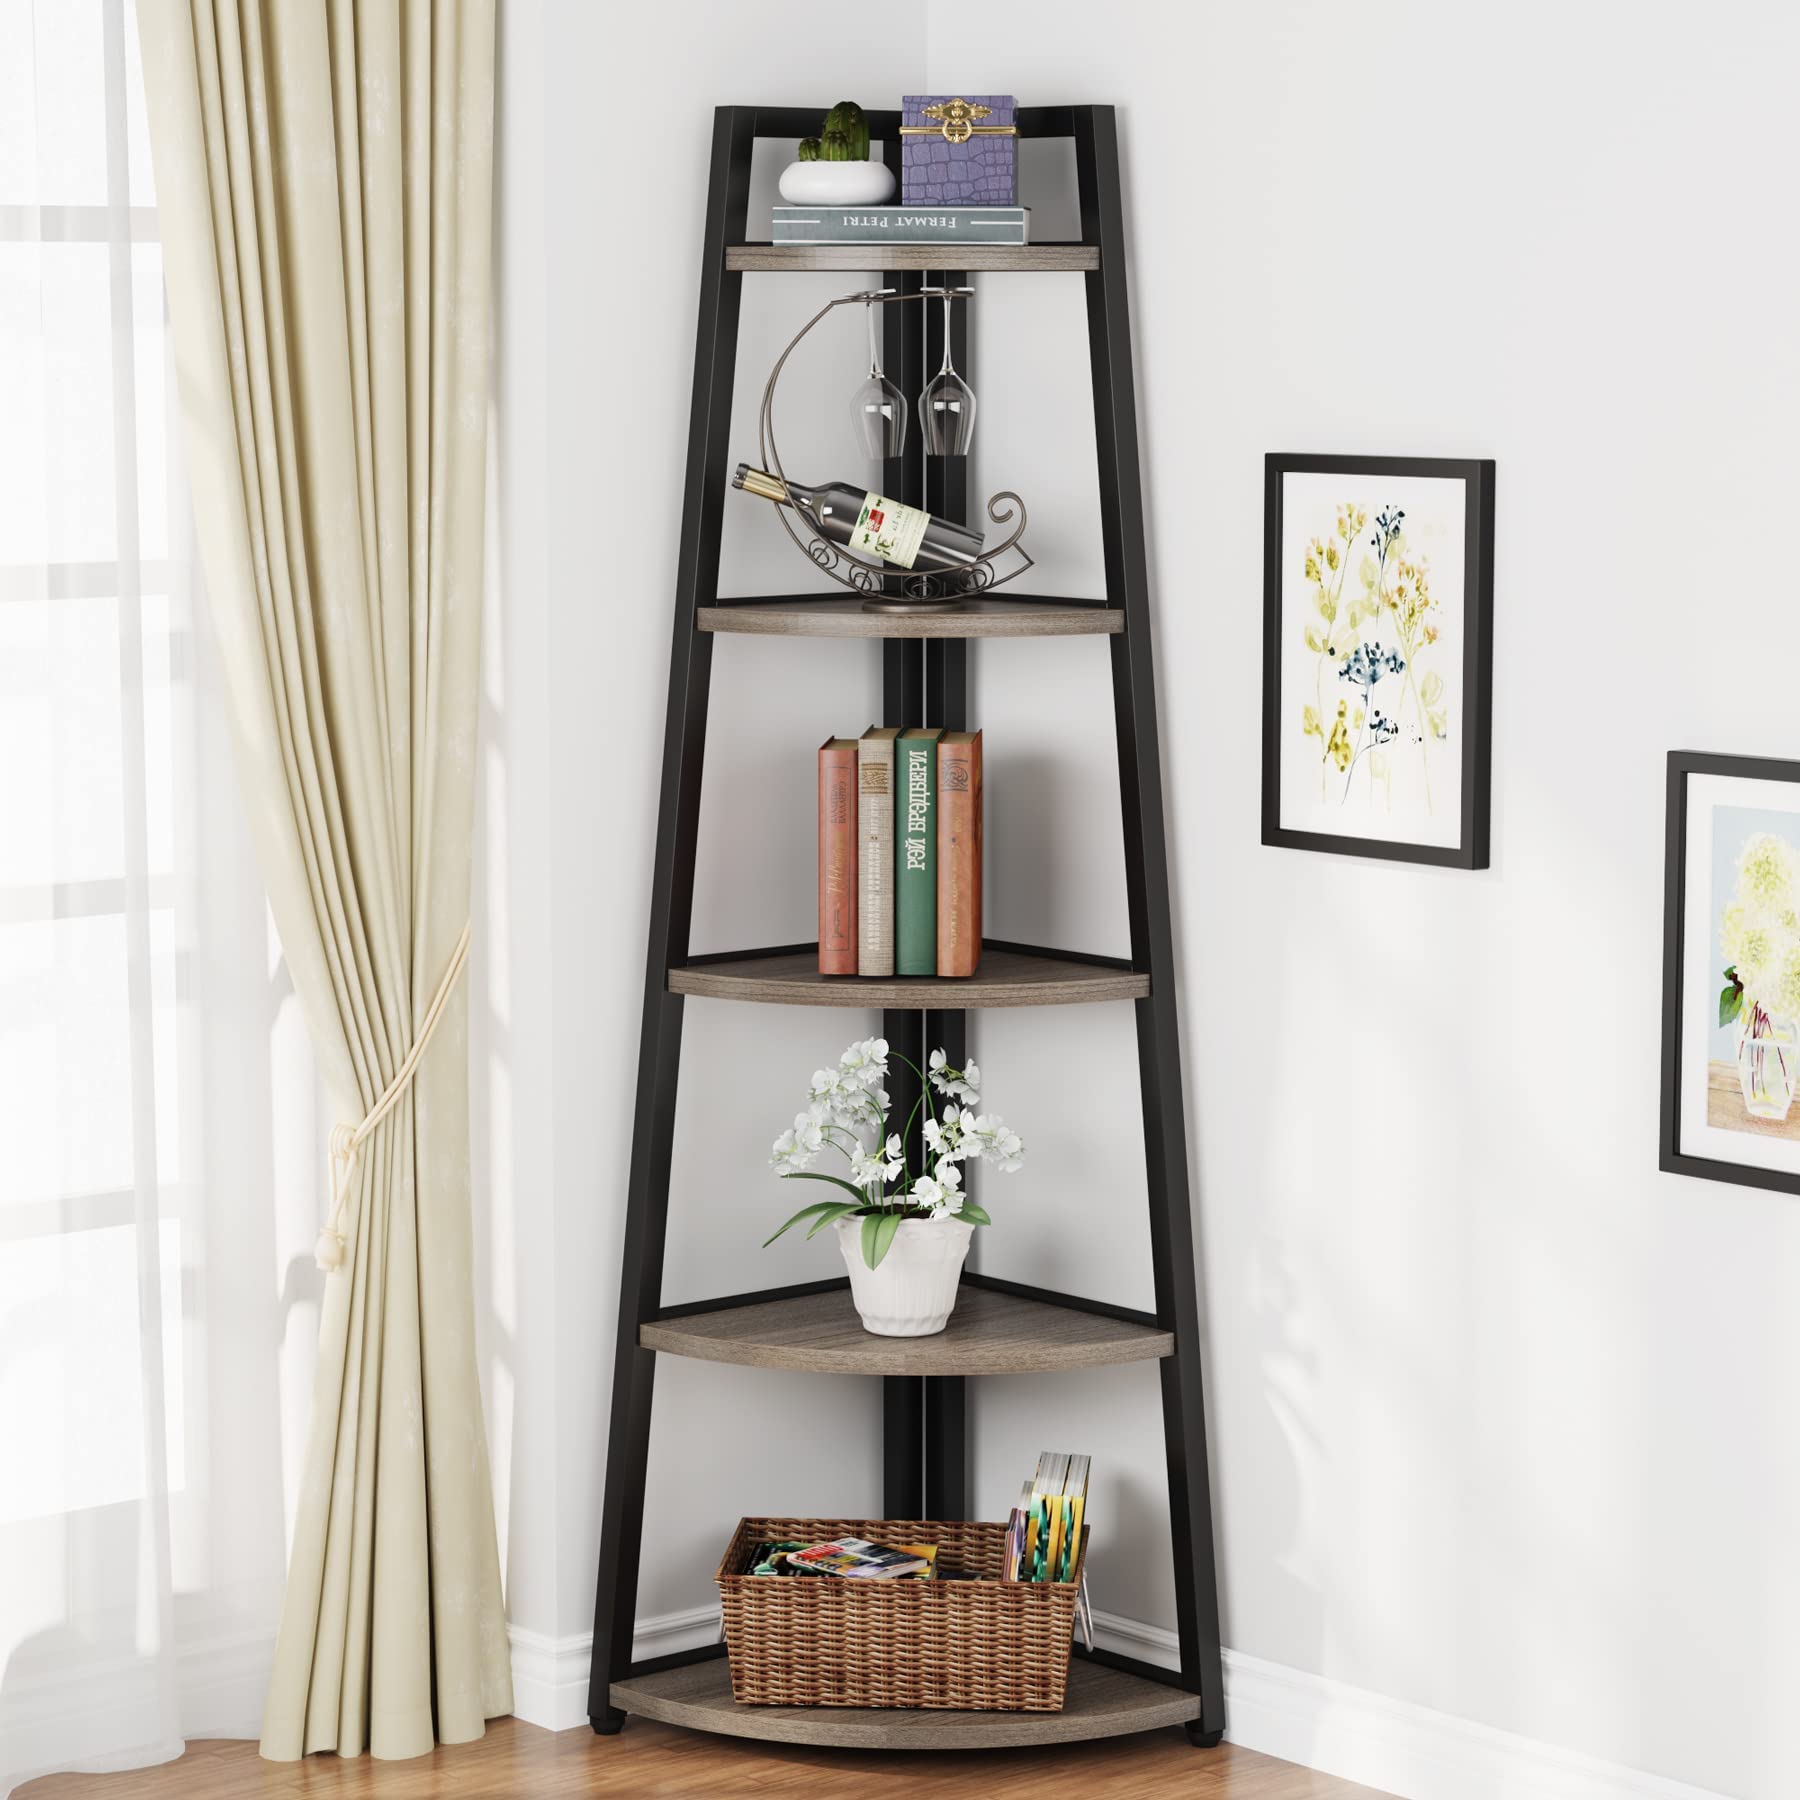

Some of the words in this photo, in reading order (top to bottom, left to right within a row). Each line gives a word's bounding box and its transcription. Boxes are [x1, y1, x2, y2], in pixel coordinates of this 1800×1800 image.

[843, 216, 888, 228] PETRI
[895, 216, 957, 228] FERMAT
[908, 750, 930, 833] БРЭДБЕРИ
[905, 838, 926, 870] РЭЙ
